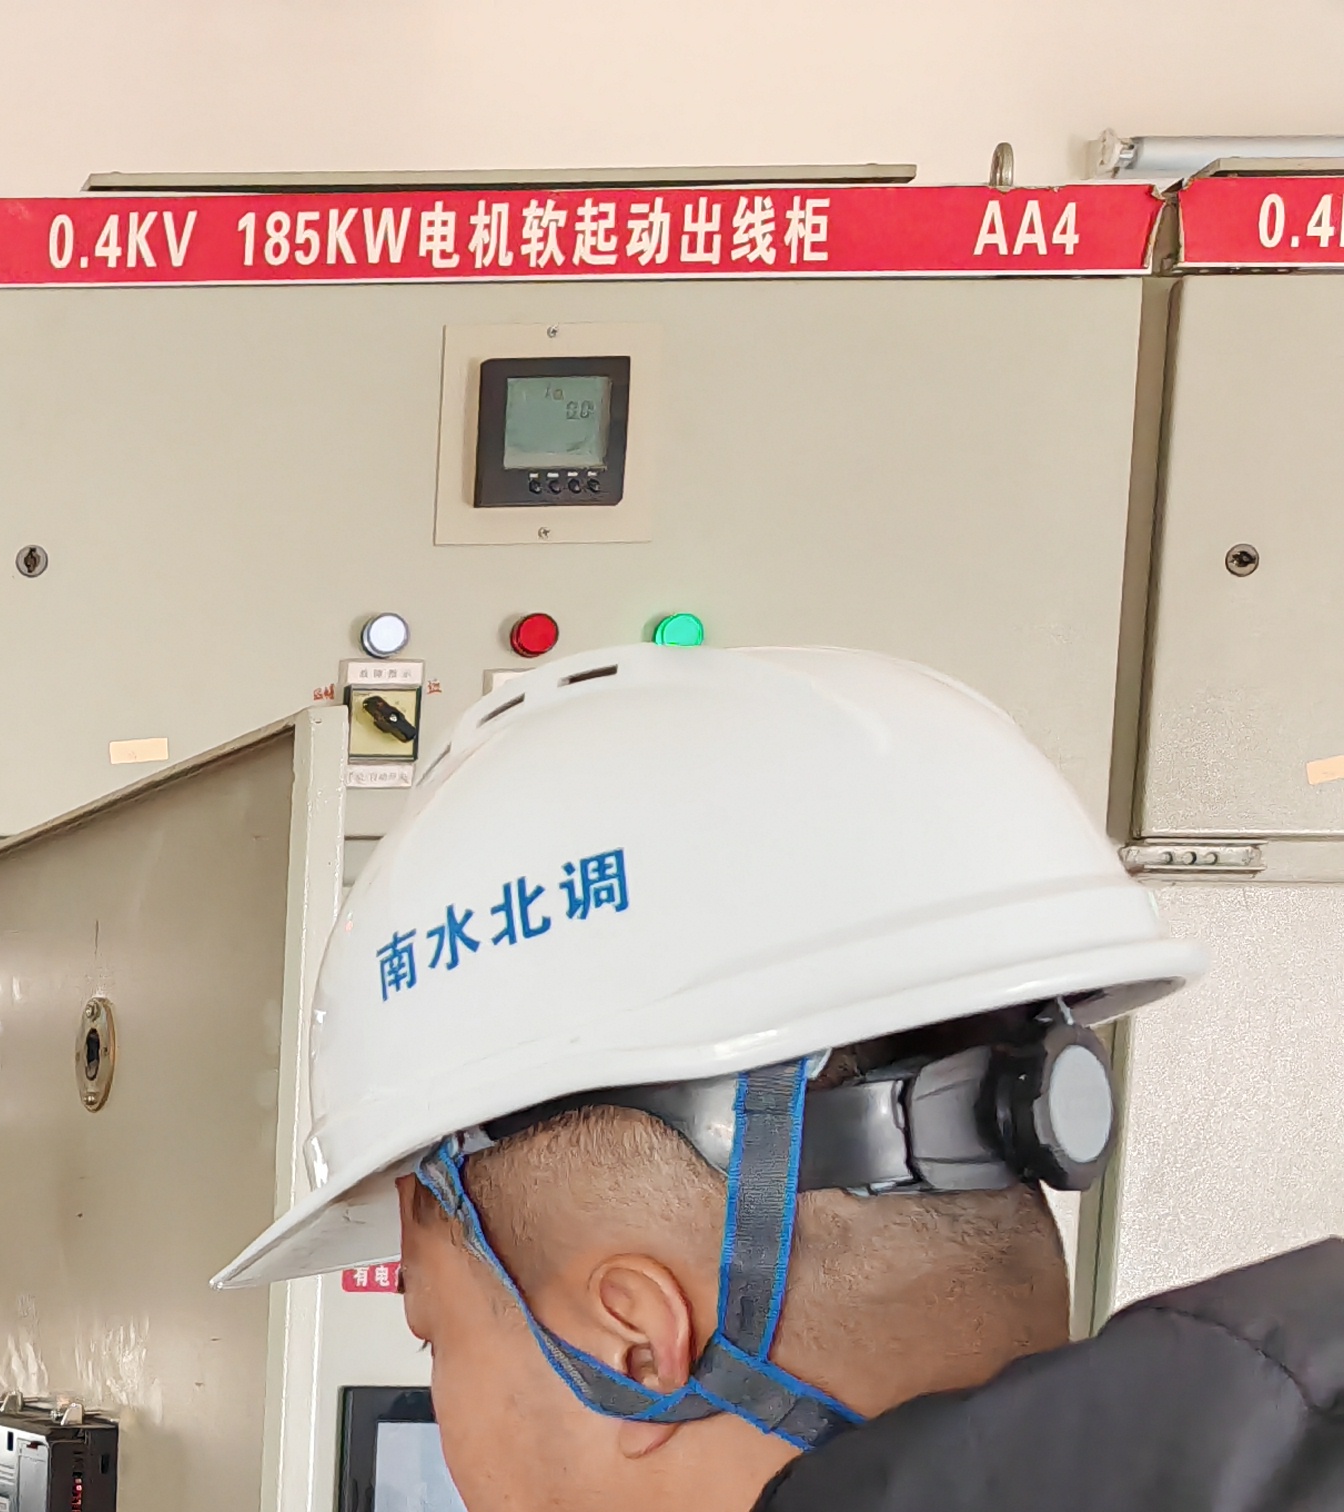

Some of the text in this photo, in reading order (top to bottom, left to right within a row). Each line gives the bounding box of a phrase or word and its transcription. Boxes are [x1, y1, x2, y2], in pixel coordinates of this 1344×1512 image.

[49, 198, 1080, 269] 0.4KV 185KW电机软起动出线柜 AA4
[1258, 193, 1344, 248] 0.4
[376, 848, 629, 1002] 南水北调
[353, 1264, 401, 1288] 有电
